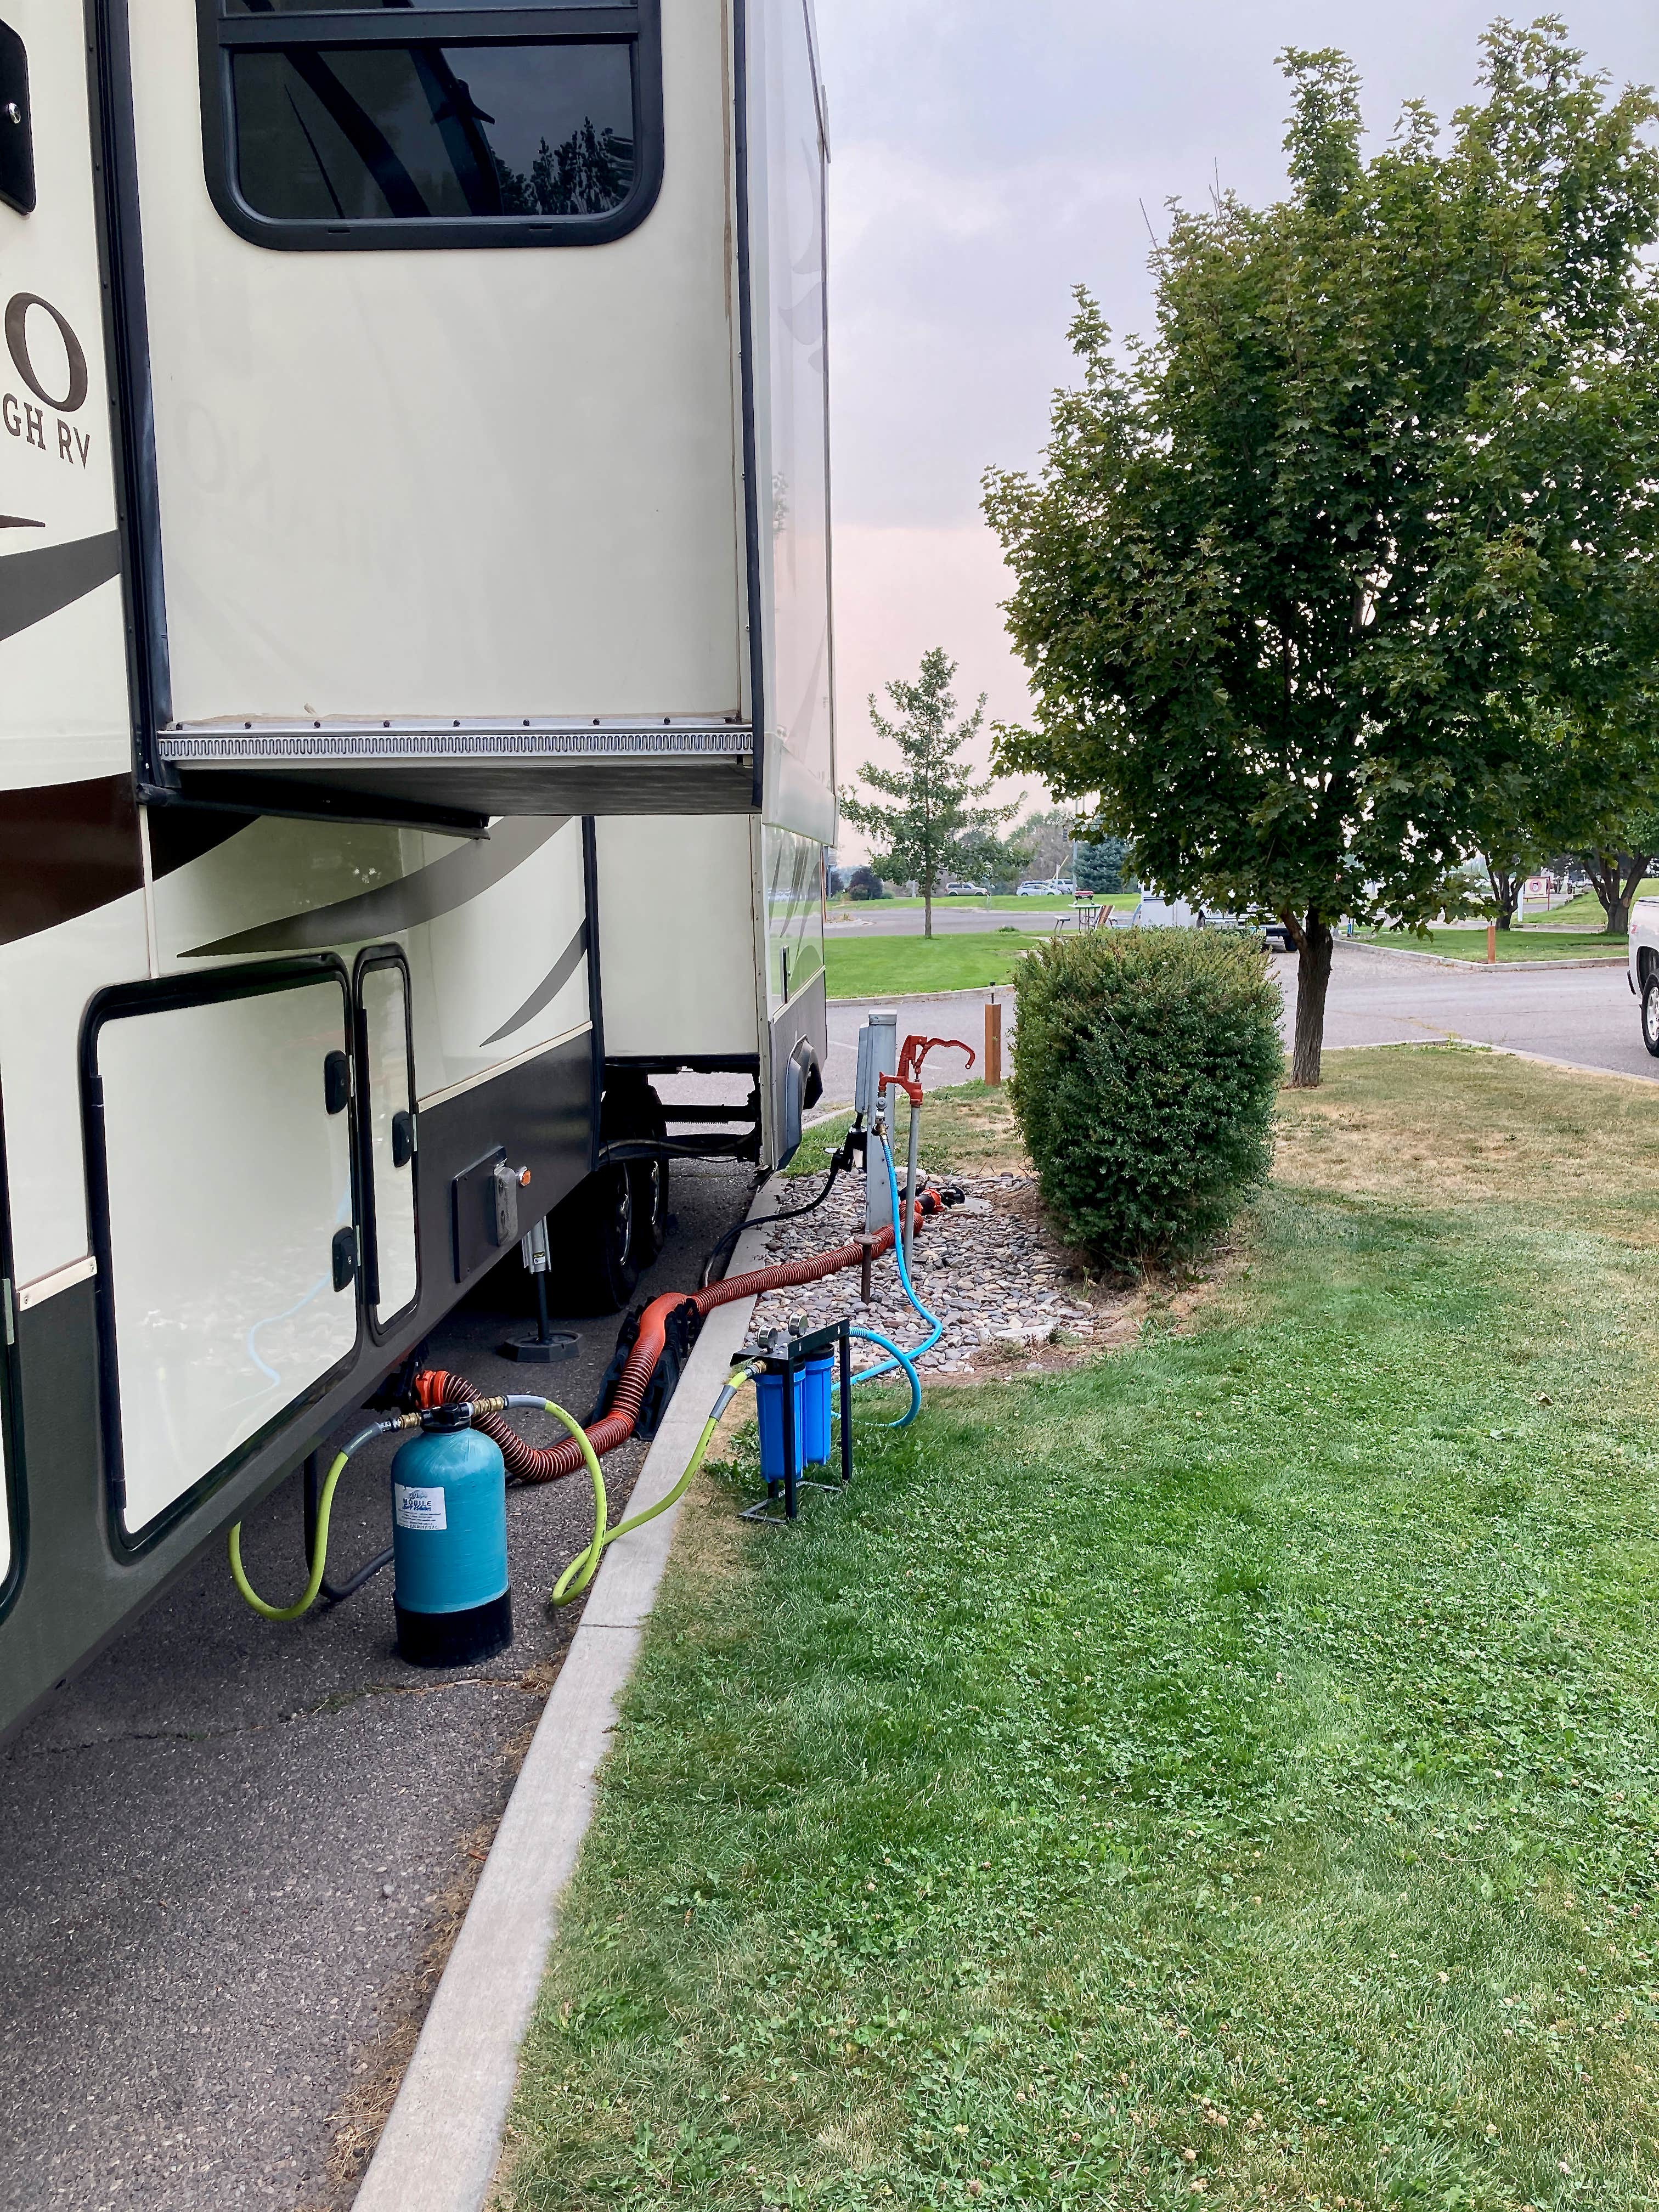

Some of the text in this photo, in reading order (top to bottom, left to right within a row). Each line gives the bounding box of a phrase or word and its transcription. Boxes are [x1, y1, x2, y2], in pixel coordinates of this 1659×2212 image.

[2, 393, 90, 470] GH RV
[403, 1498, 432, 1506] MOBILE
